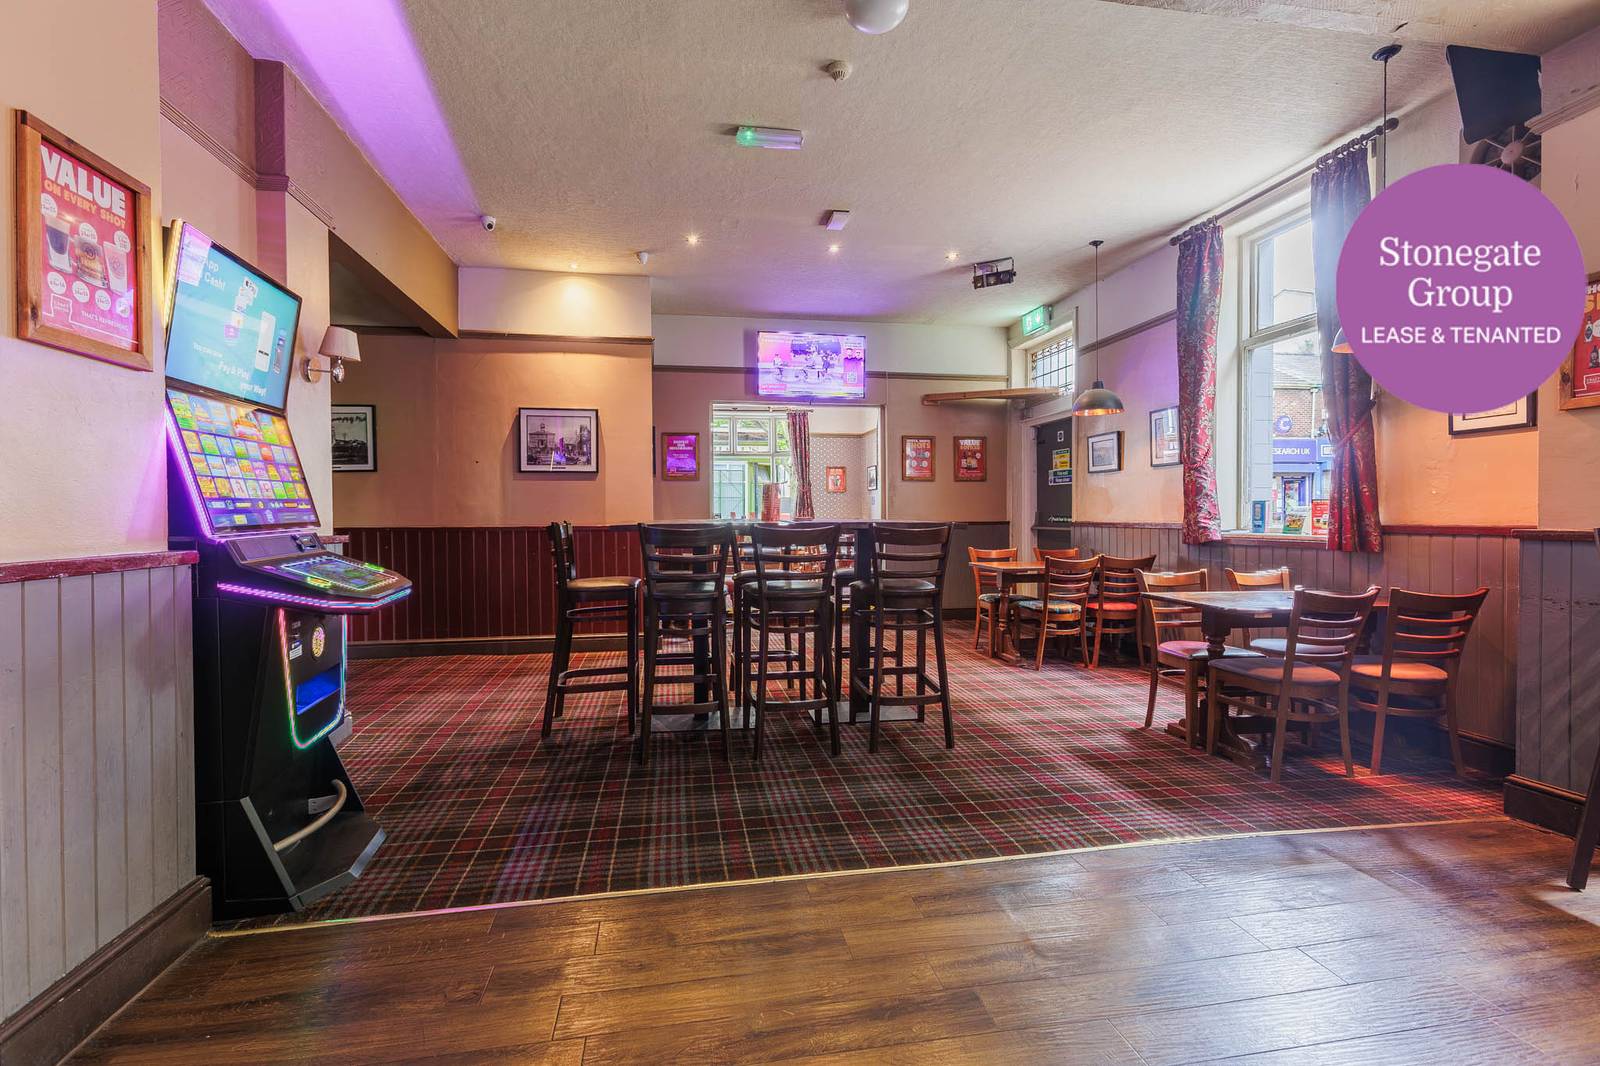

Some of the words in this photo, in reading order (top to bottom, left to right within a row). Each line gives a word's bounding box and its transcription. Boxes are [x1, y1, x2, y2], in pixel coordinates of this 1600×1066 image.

[40, 144, 126, 218] VALUE
[63, 190, 97, 214] EVERY
[100, 208, 126, 230] SHOT
